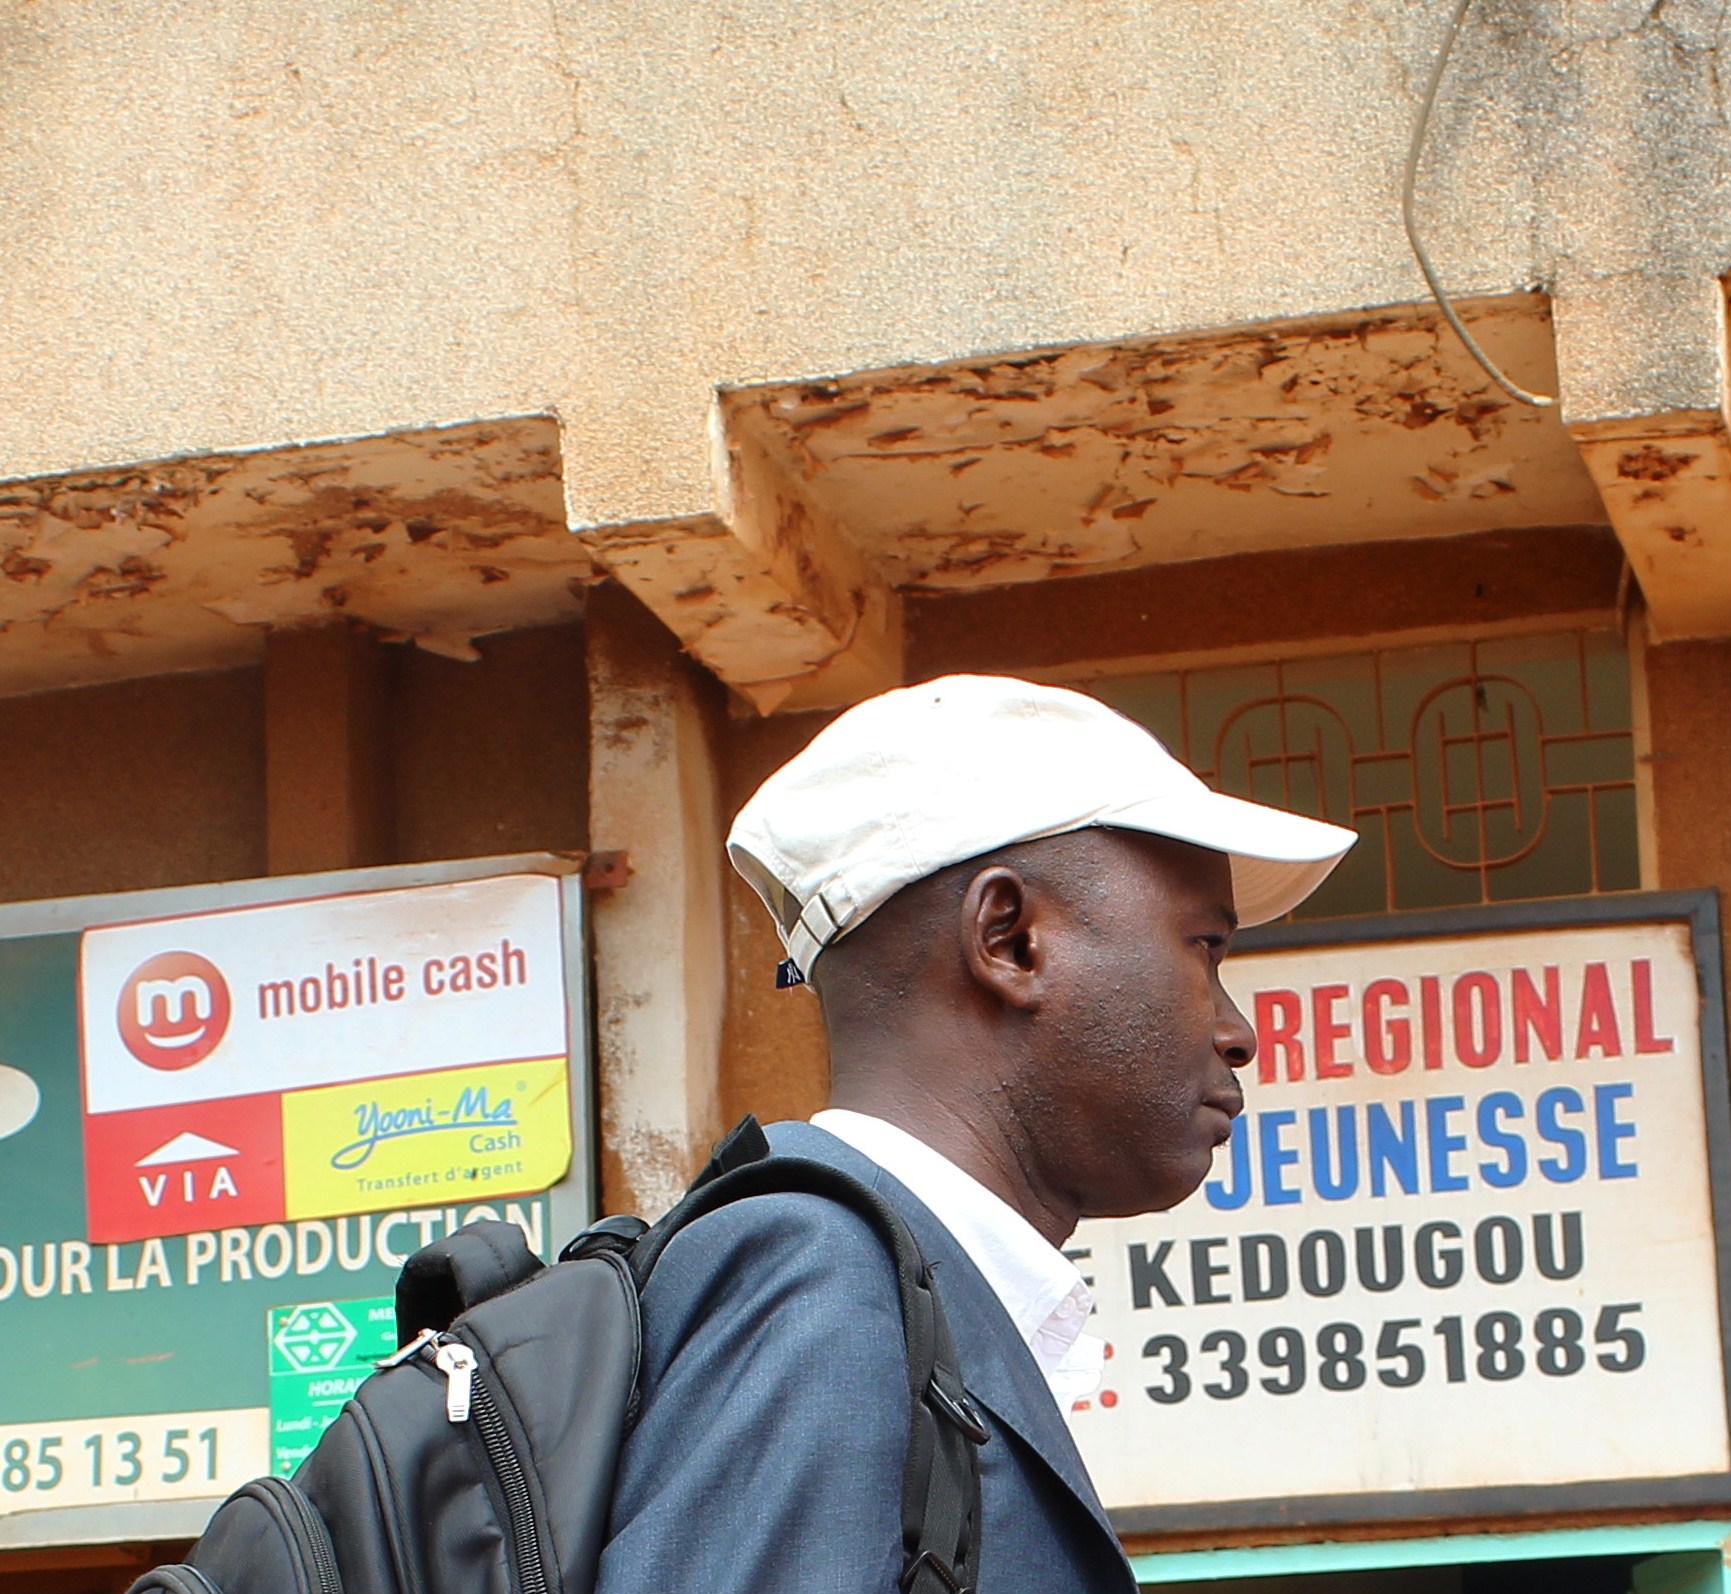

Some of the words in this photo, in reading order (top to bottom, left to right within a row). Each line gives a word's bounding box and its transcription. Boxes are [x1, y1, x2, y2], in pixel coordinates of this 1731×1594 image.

[258, 957, 405, 1020] mobile
[422, 939, 527, 997] cash
[1253, 958, 1674, 1085] REGIONAL
[331, 1086, 517, 1169] Yooni-Ma
[469, 1131, 521, 1154] Cash
[1204, 1082, 1640, 1211] JEUNESSE
[138, 1166, 239, 1207] VIA
[357, 1170, 439, 1192] Transfert
[445, 1161, 523, 1181] d'argent
[107, 1239, 172, 1291] LA
[1126, 1211, 1585, 1310] KEDOUGOU
[1141, 1302, 1647, 1406] 339851885
[2, 1436, 64, 1493] 85
[84, 1431, 143, 1486] 13
[161, 1427, 218, 1484] 51
